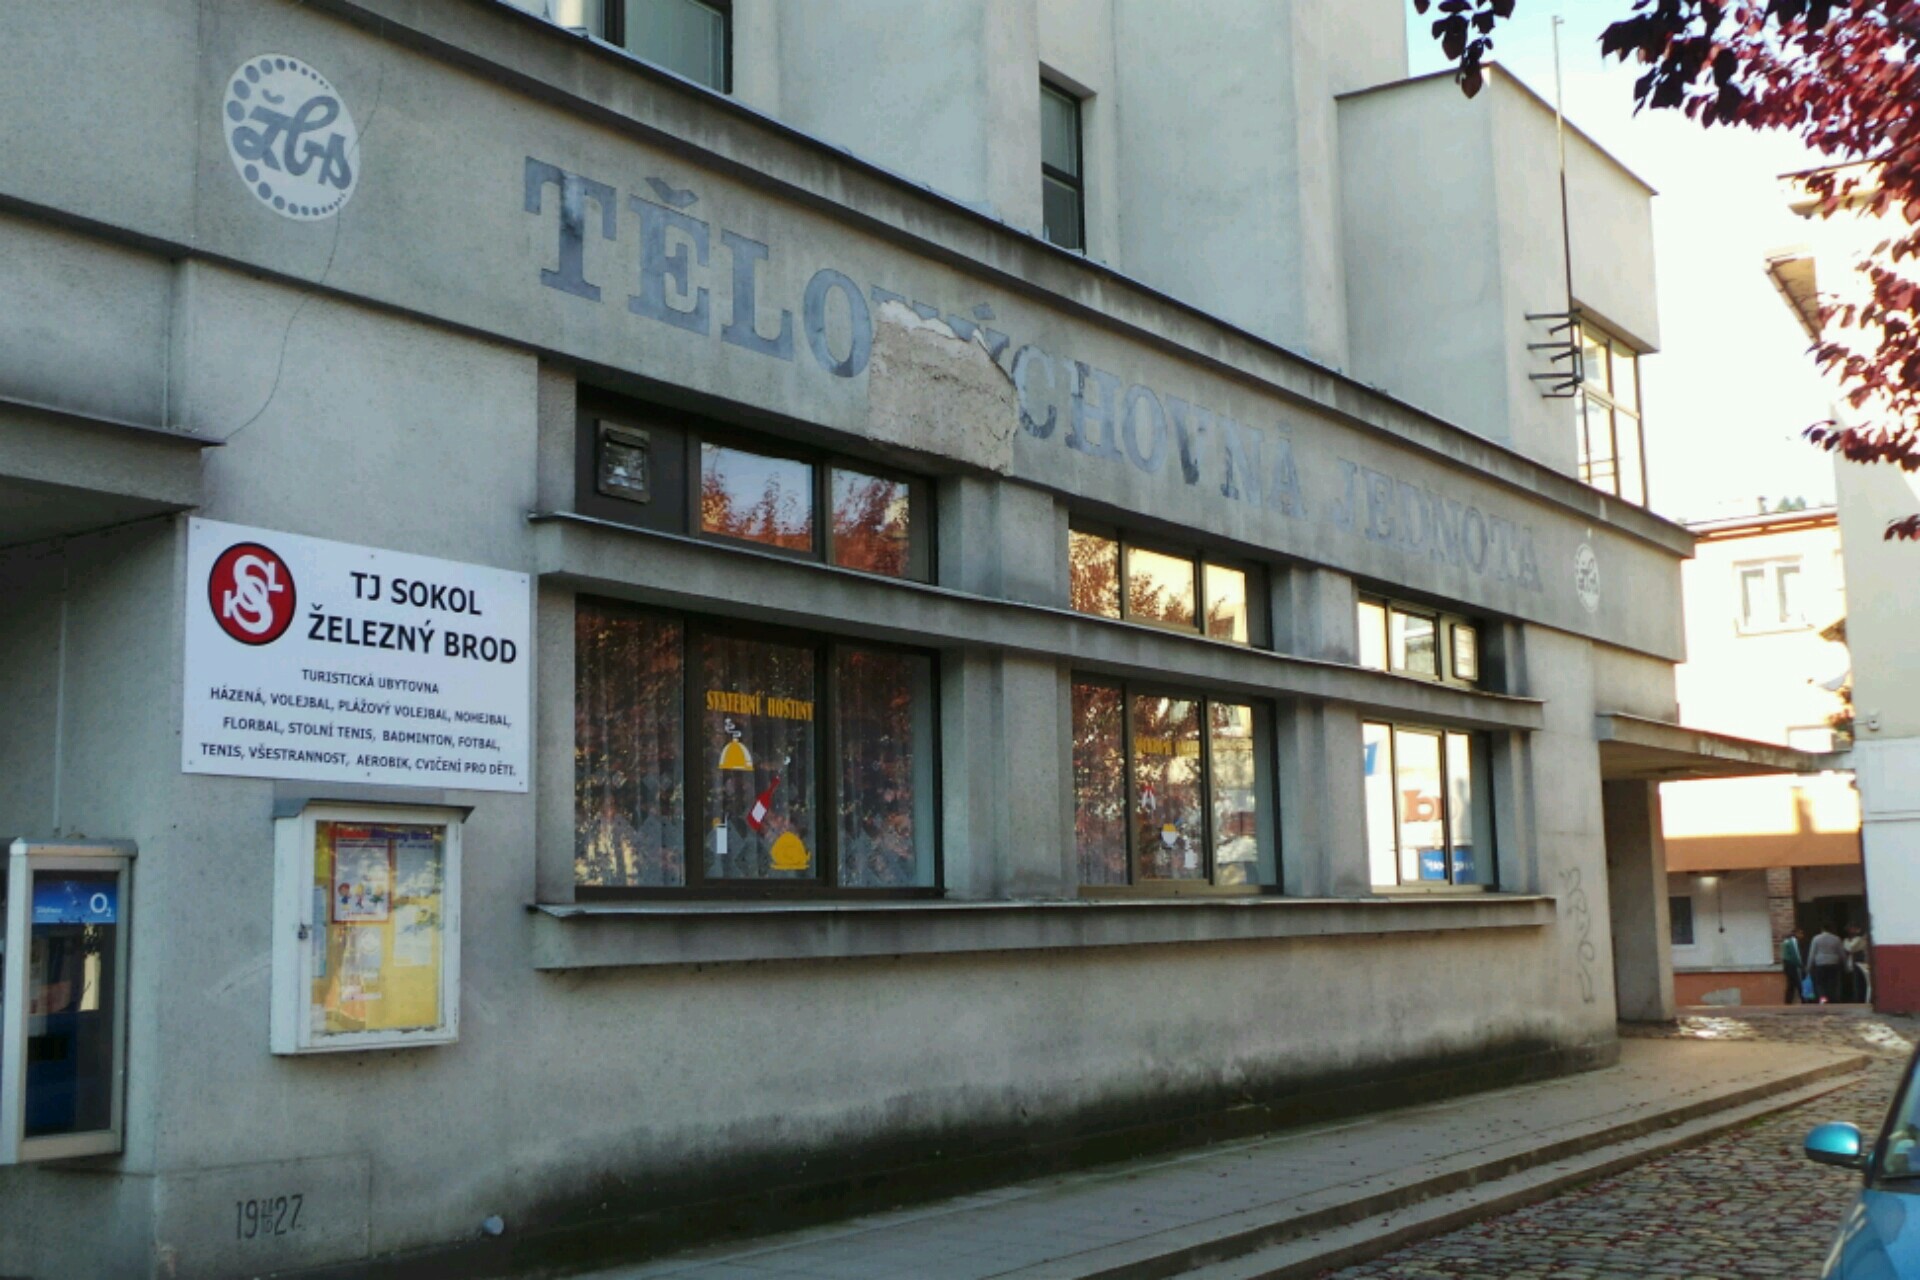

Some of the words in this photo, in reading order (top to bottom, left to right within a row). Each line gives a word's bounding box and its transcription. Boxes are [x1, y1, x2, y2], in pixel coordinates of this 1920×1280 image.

[524, 155, 1308, 518] TĚLOCHOVNÁ
[1331, 456, 1545, 594] JEDNOTA
[351, 571, 381, 601] TJ
[390, 577, 482, 616] SOKOL
[307, 602, 435, 654] ŽELEZNÝ
[444, 632, 517, 664] BROD
[301, 668, 374, 687] TURISTICKÁ
[378, 677, 439, 695] UBYTOVNA
[210, 683, 267, 706] HÁZENÁ,
[270, 692, 335, 712] VOLEJBAL,
[338, 698, 392, 715] PLÁŽOVÝ
[394, 705, 451, 723] VOLEJBAL,
[454, 710, 512, 729] NOHEJBAL,
[222, 716, 284, 735] FLORBAL,
[287, 721, 334, 738] STOLNÍ
[337, 726, 376, 743] TENIS,
[382, 730, 455, 748] BADMINTON,
[457, 736, 501, 752] FOTBAL,
[200, 742, 245, 760] TENIS,
[248, 742, 350, 767] VŠESTRANNOST,
[356, 753, 412, 771] AEROBIK,
[414, 755, 461, 773] CVIČENÍ
[463, 761, 486, 774] PRO
[489, 760, 516, 776] DĚTI.
